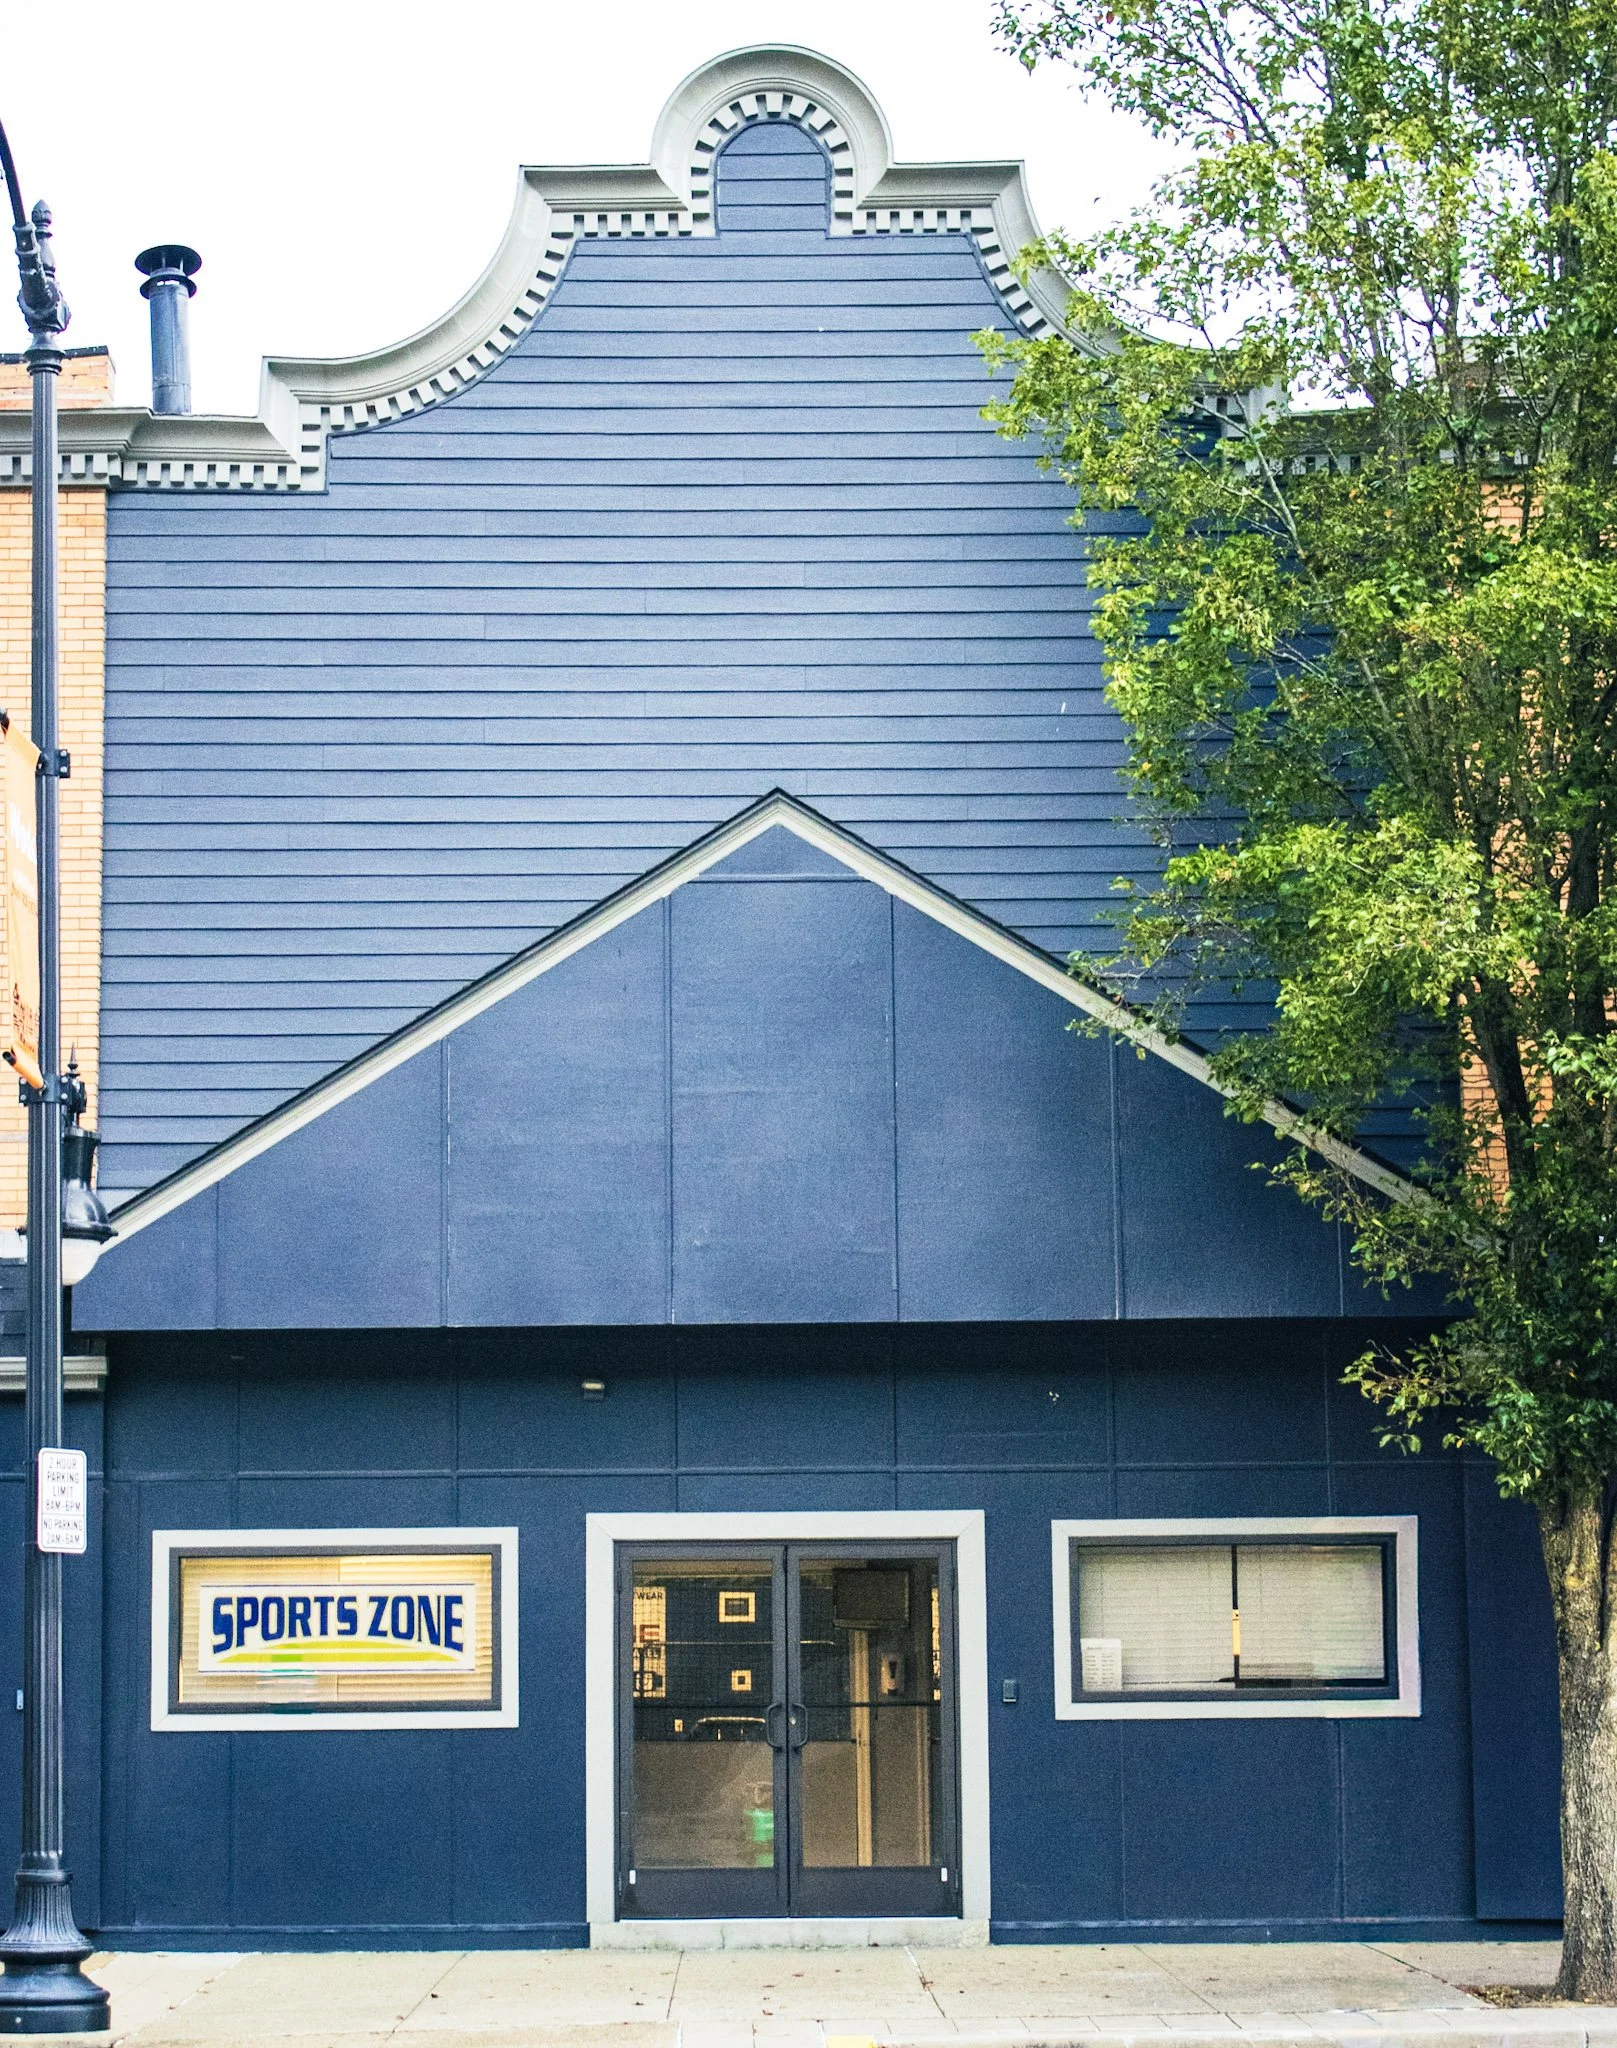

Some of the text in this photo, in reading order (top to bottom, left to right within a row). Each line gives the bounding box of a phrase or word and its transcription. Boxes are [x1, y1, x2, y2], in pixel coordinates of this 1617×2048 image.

[48, 1456, 77, 1469] 2 HOUR
[47, 1470, 79, 1484] PARKING
[53, 1485, 73, 1497] LIMIT
[43, 1518, 82, 1531] NO PARKING
[212, 1595, 464, 1654] SPORTS ZONE
